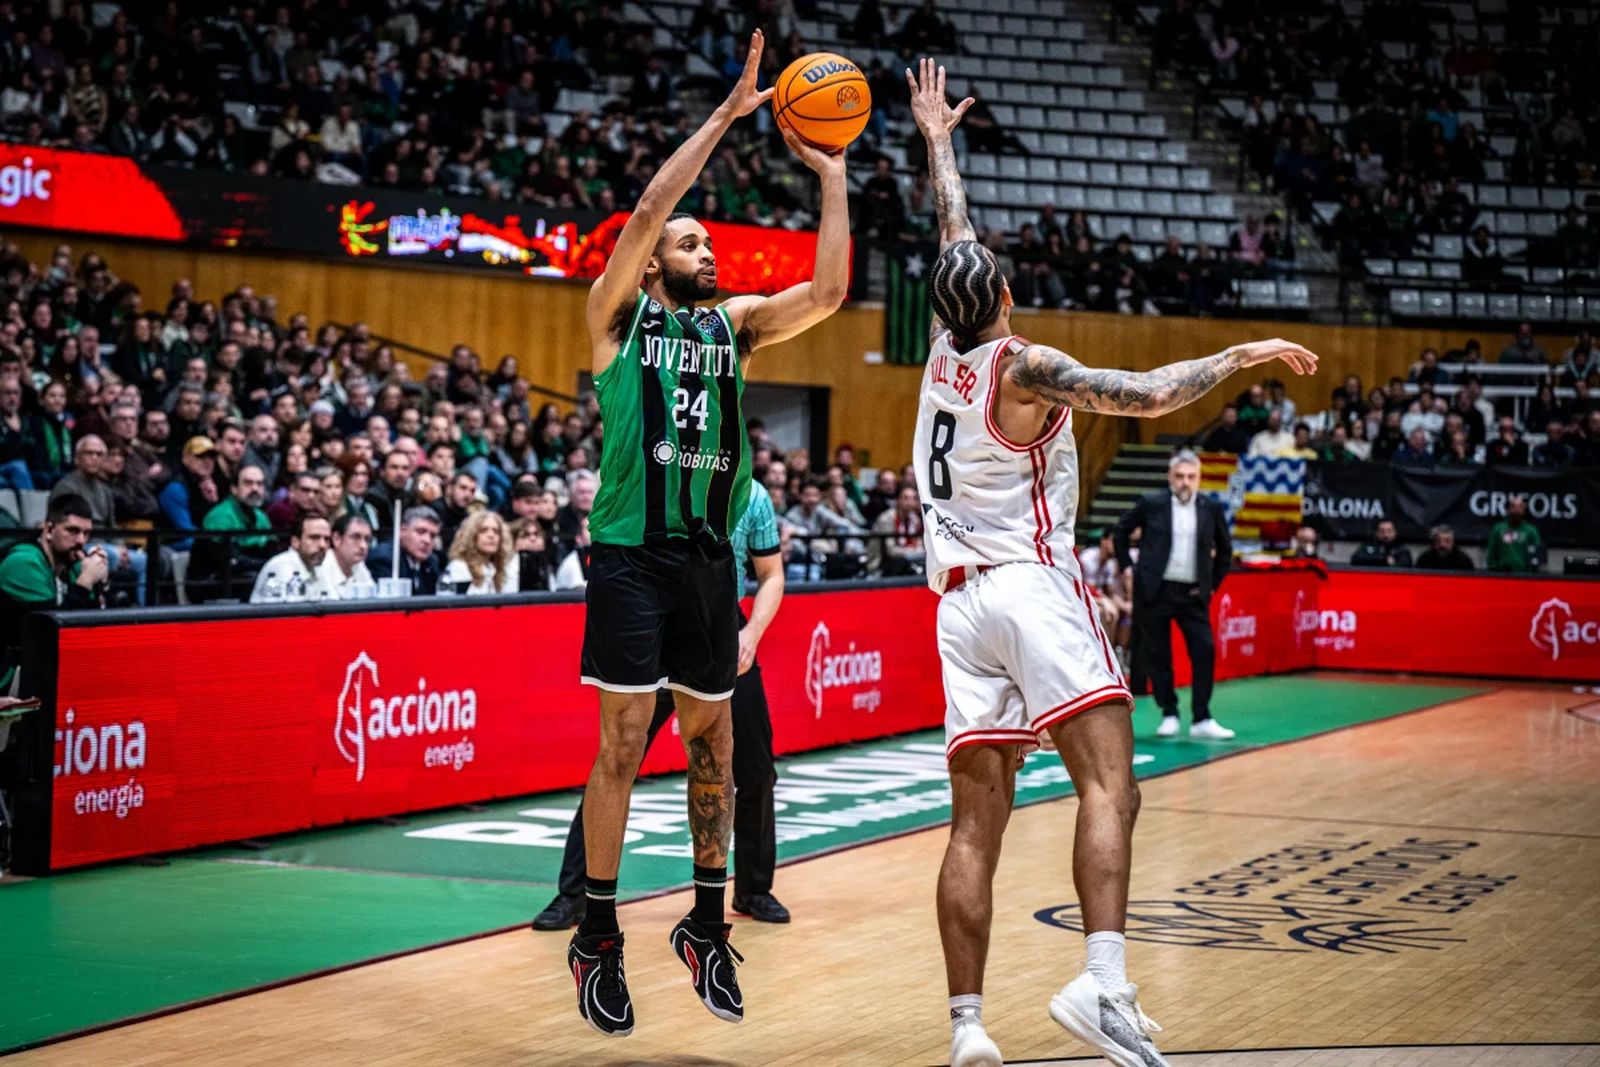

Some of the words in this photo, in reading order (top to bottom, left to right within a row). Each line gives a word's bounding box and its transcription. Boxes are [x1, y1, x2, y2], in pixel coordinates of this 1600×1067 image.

[641, 334, 736, 377] JOVENTUT
[671, 388, 709, 431] 24
[929, 409, 956, 500] 8
[1562, 620, 1600, 644] ac
[823, 641, 881, 689] acciona
[367, 676, 476, 741] acciona
[424, 735, 475, 771] energía
[74, 777, 144, 818] energía
